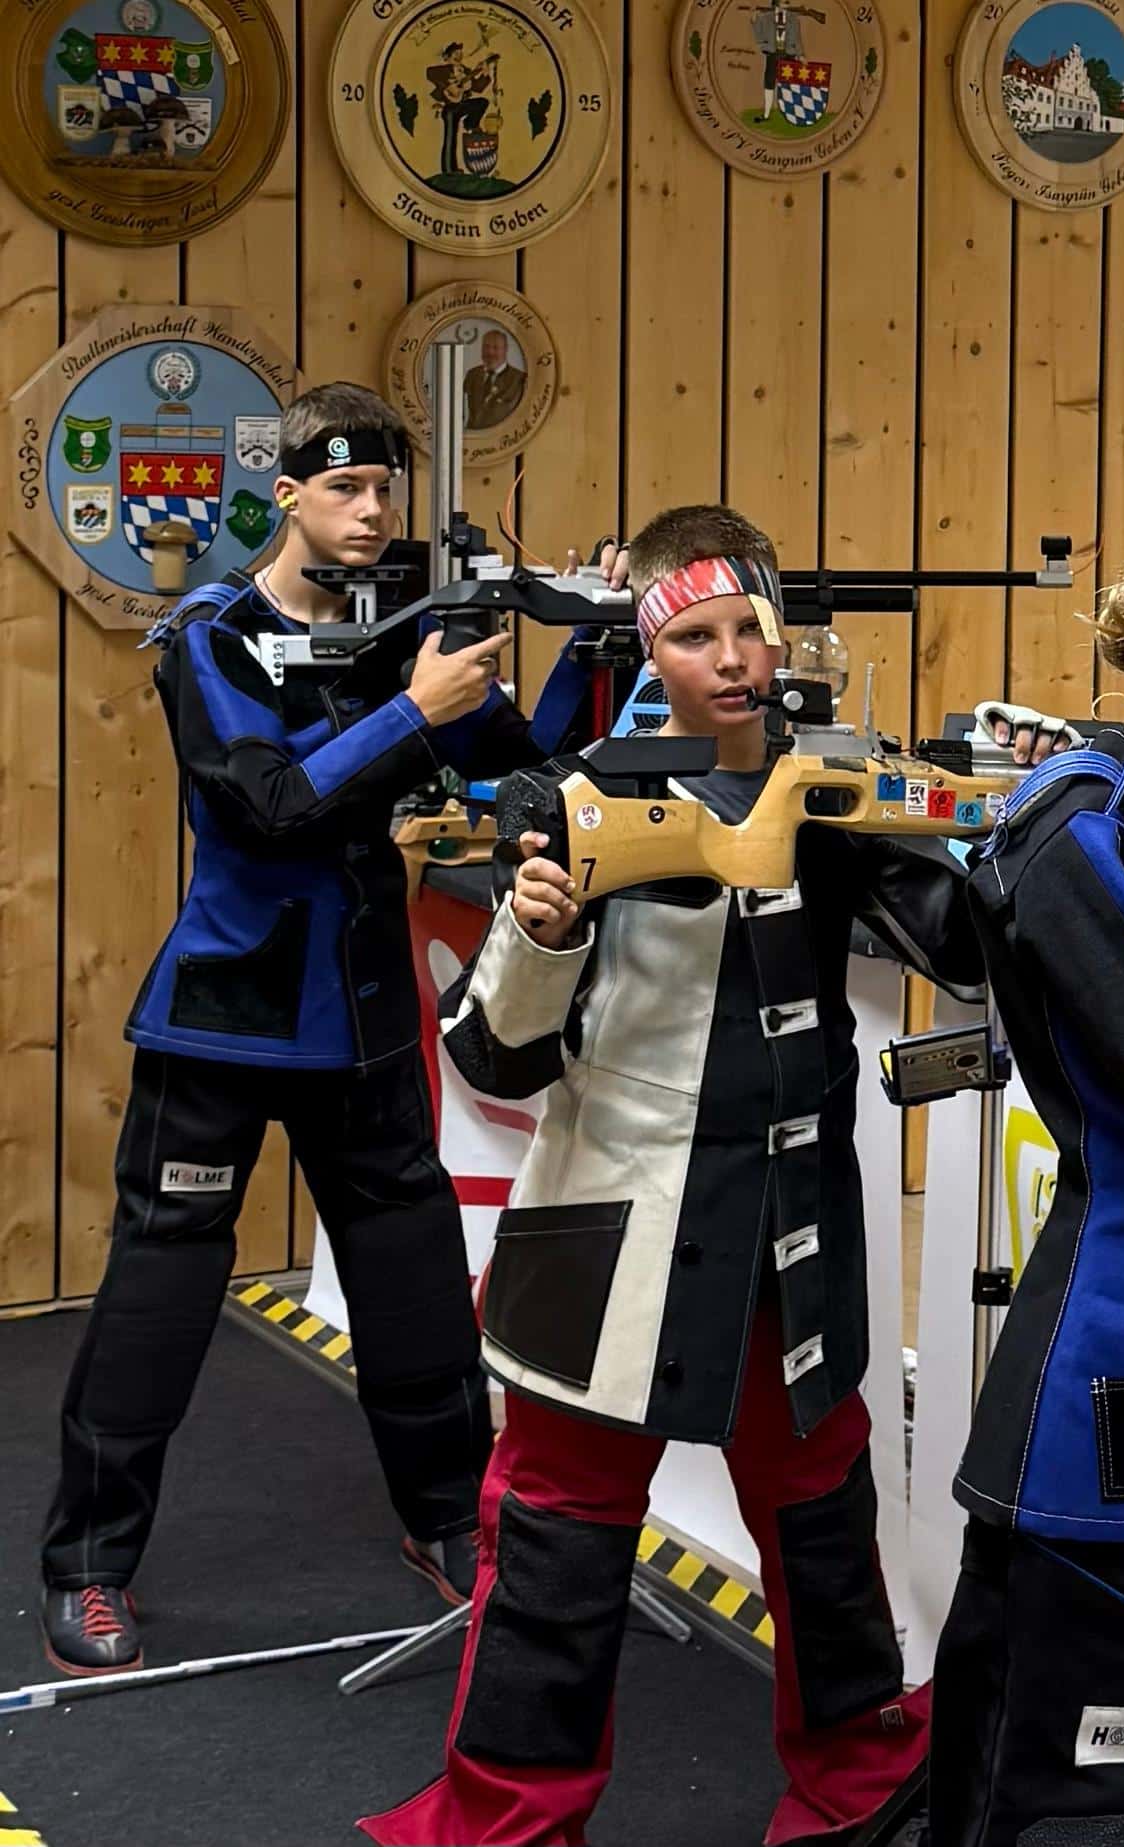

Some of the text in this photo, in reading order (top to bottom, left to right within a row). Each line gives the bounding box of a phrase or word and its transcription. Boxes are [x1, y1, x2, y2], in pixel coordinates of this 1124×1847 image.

[341, 83, 364, 101] 20
[578, 94, 601, 112] 25
[489, 200, 549, 235] Goben
[580, 857, 597, 892] 7
